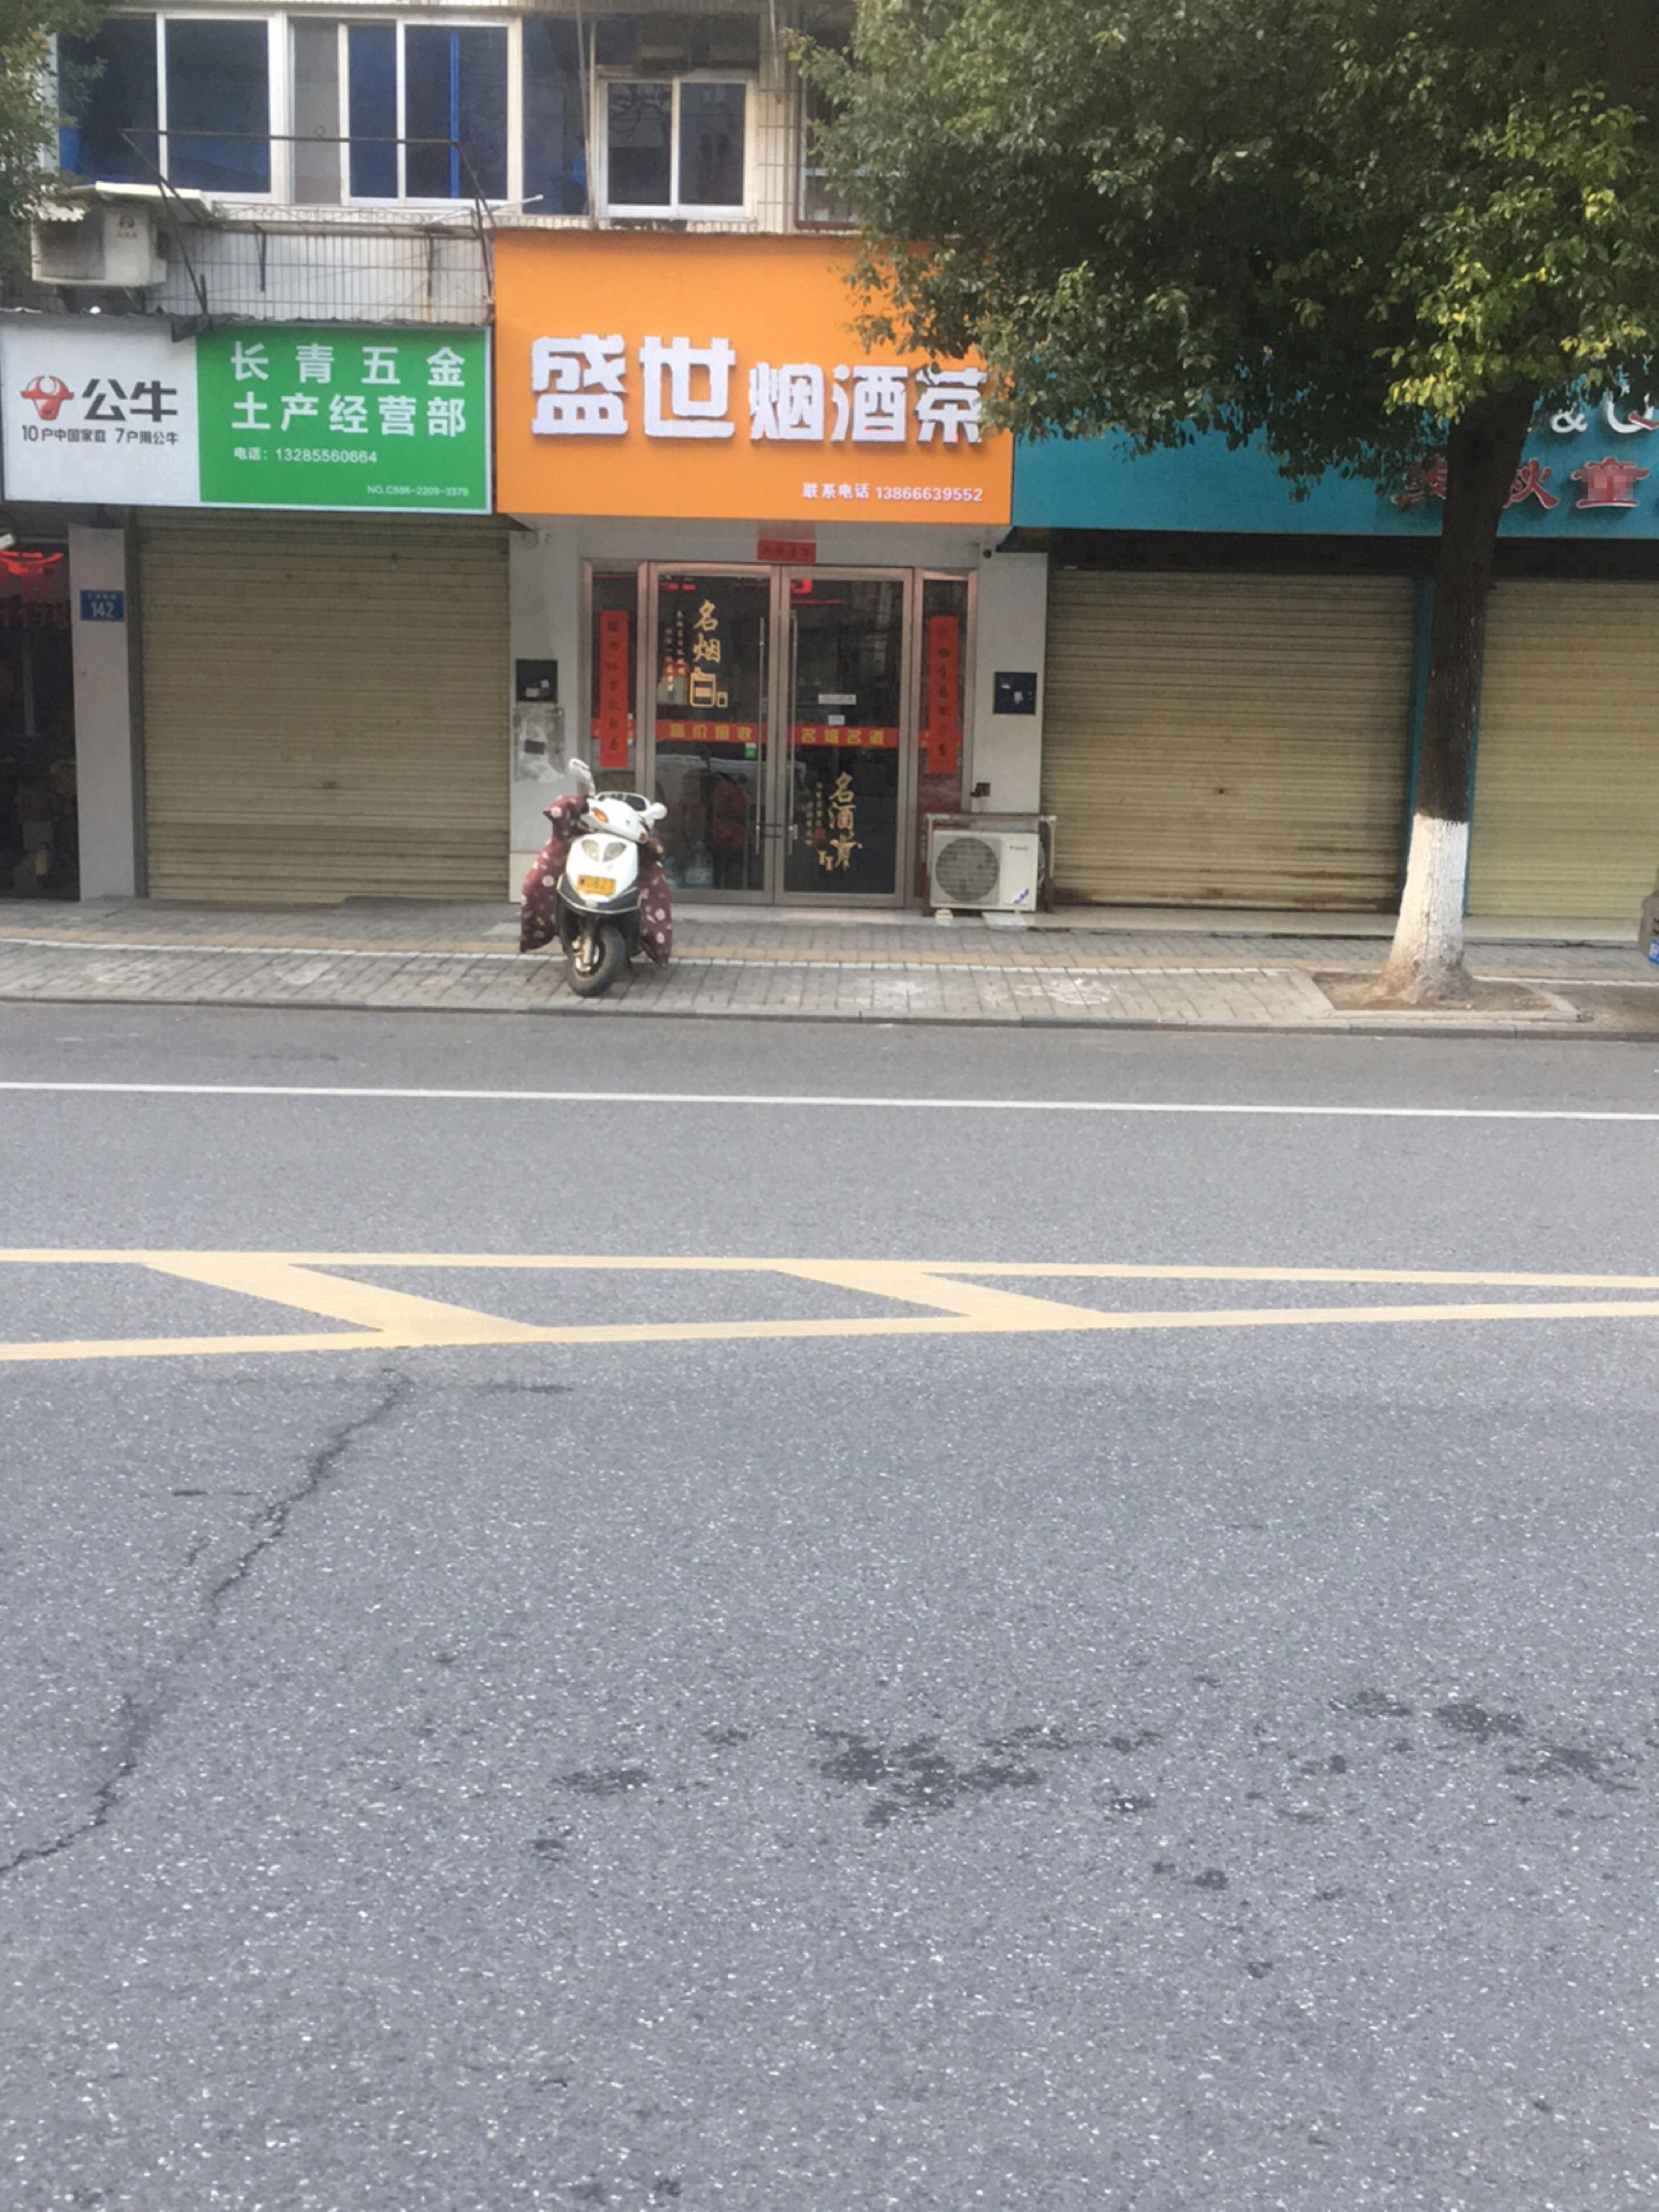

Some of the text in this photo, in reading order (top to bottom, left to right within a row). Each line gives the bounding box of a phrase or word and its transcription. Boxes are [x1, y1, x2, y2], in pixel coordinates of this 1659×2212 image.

[230, 341, 466, 388] 长青五金
[83, 378, 178, 422] 公牛
[231, 391, 467, 438] 土产经营部
[801, 482, 984, 502] 联系电话 13866639552
[90, 602, 115, 618] 142
